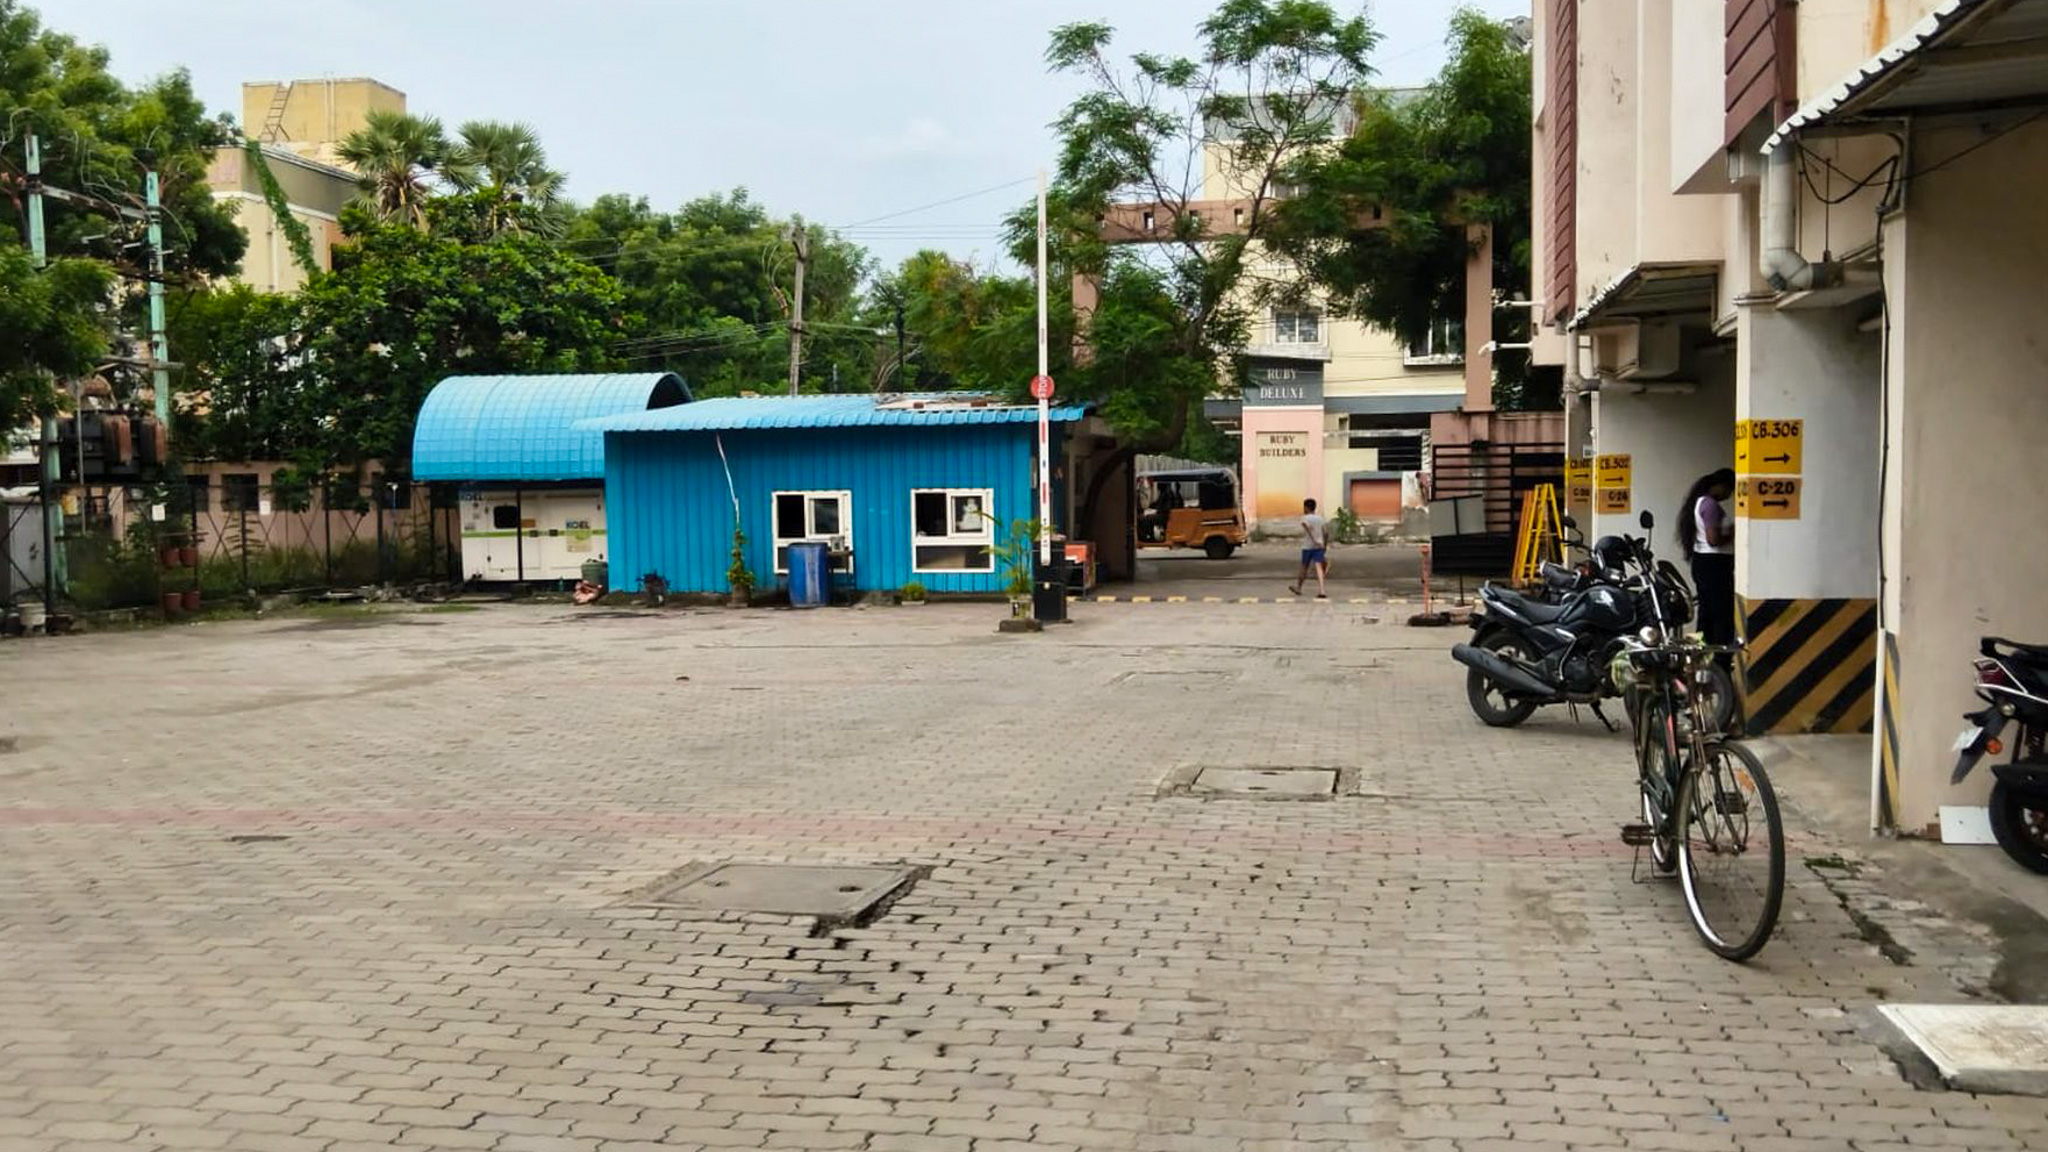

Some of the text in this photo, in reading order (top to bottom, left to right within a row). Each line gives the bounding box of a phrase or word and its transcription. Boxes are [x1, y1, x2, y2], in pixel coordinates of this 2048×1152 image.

[1267, 369, 1297, 380] RUBY
[1270, 435, 1295, 444] RUBY
[1259, 449, 1306, 457] BUILDERS
[1758, 481, 1795, 496] C-20
[566, 521, 590, 529] KOEL
